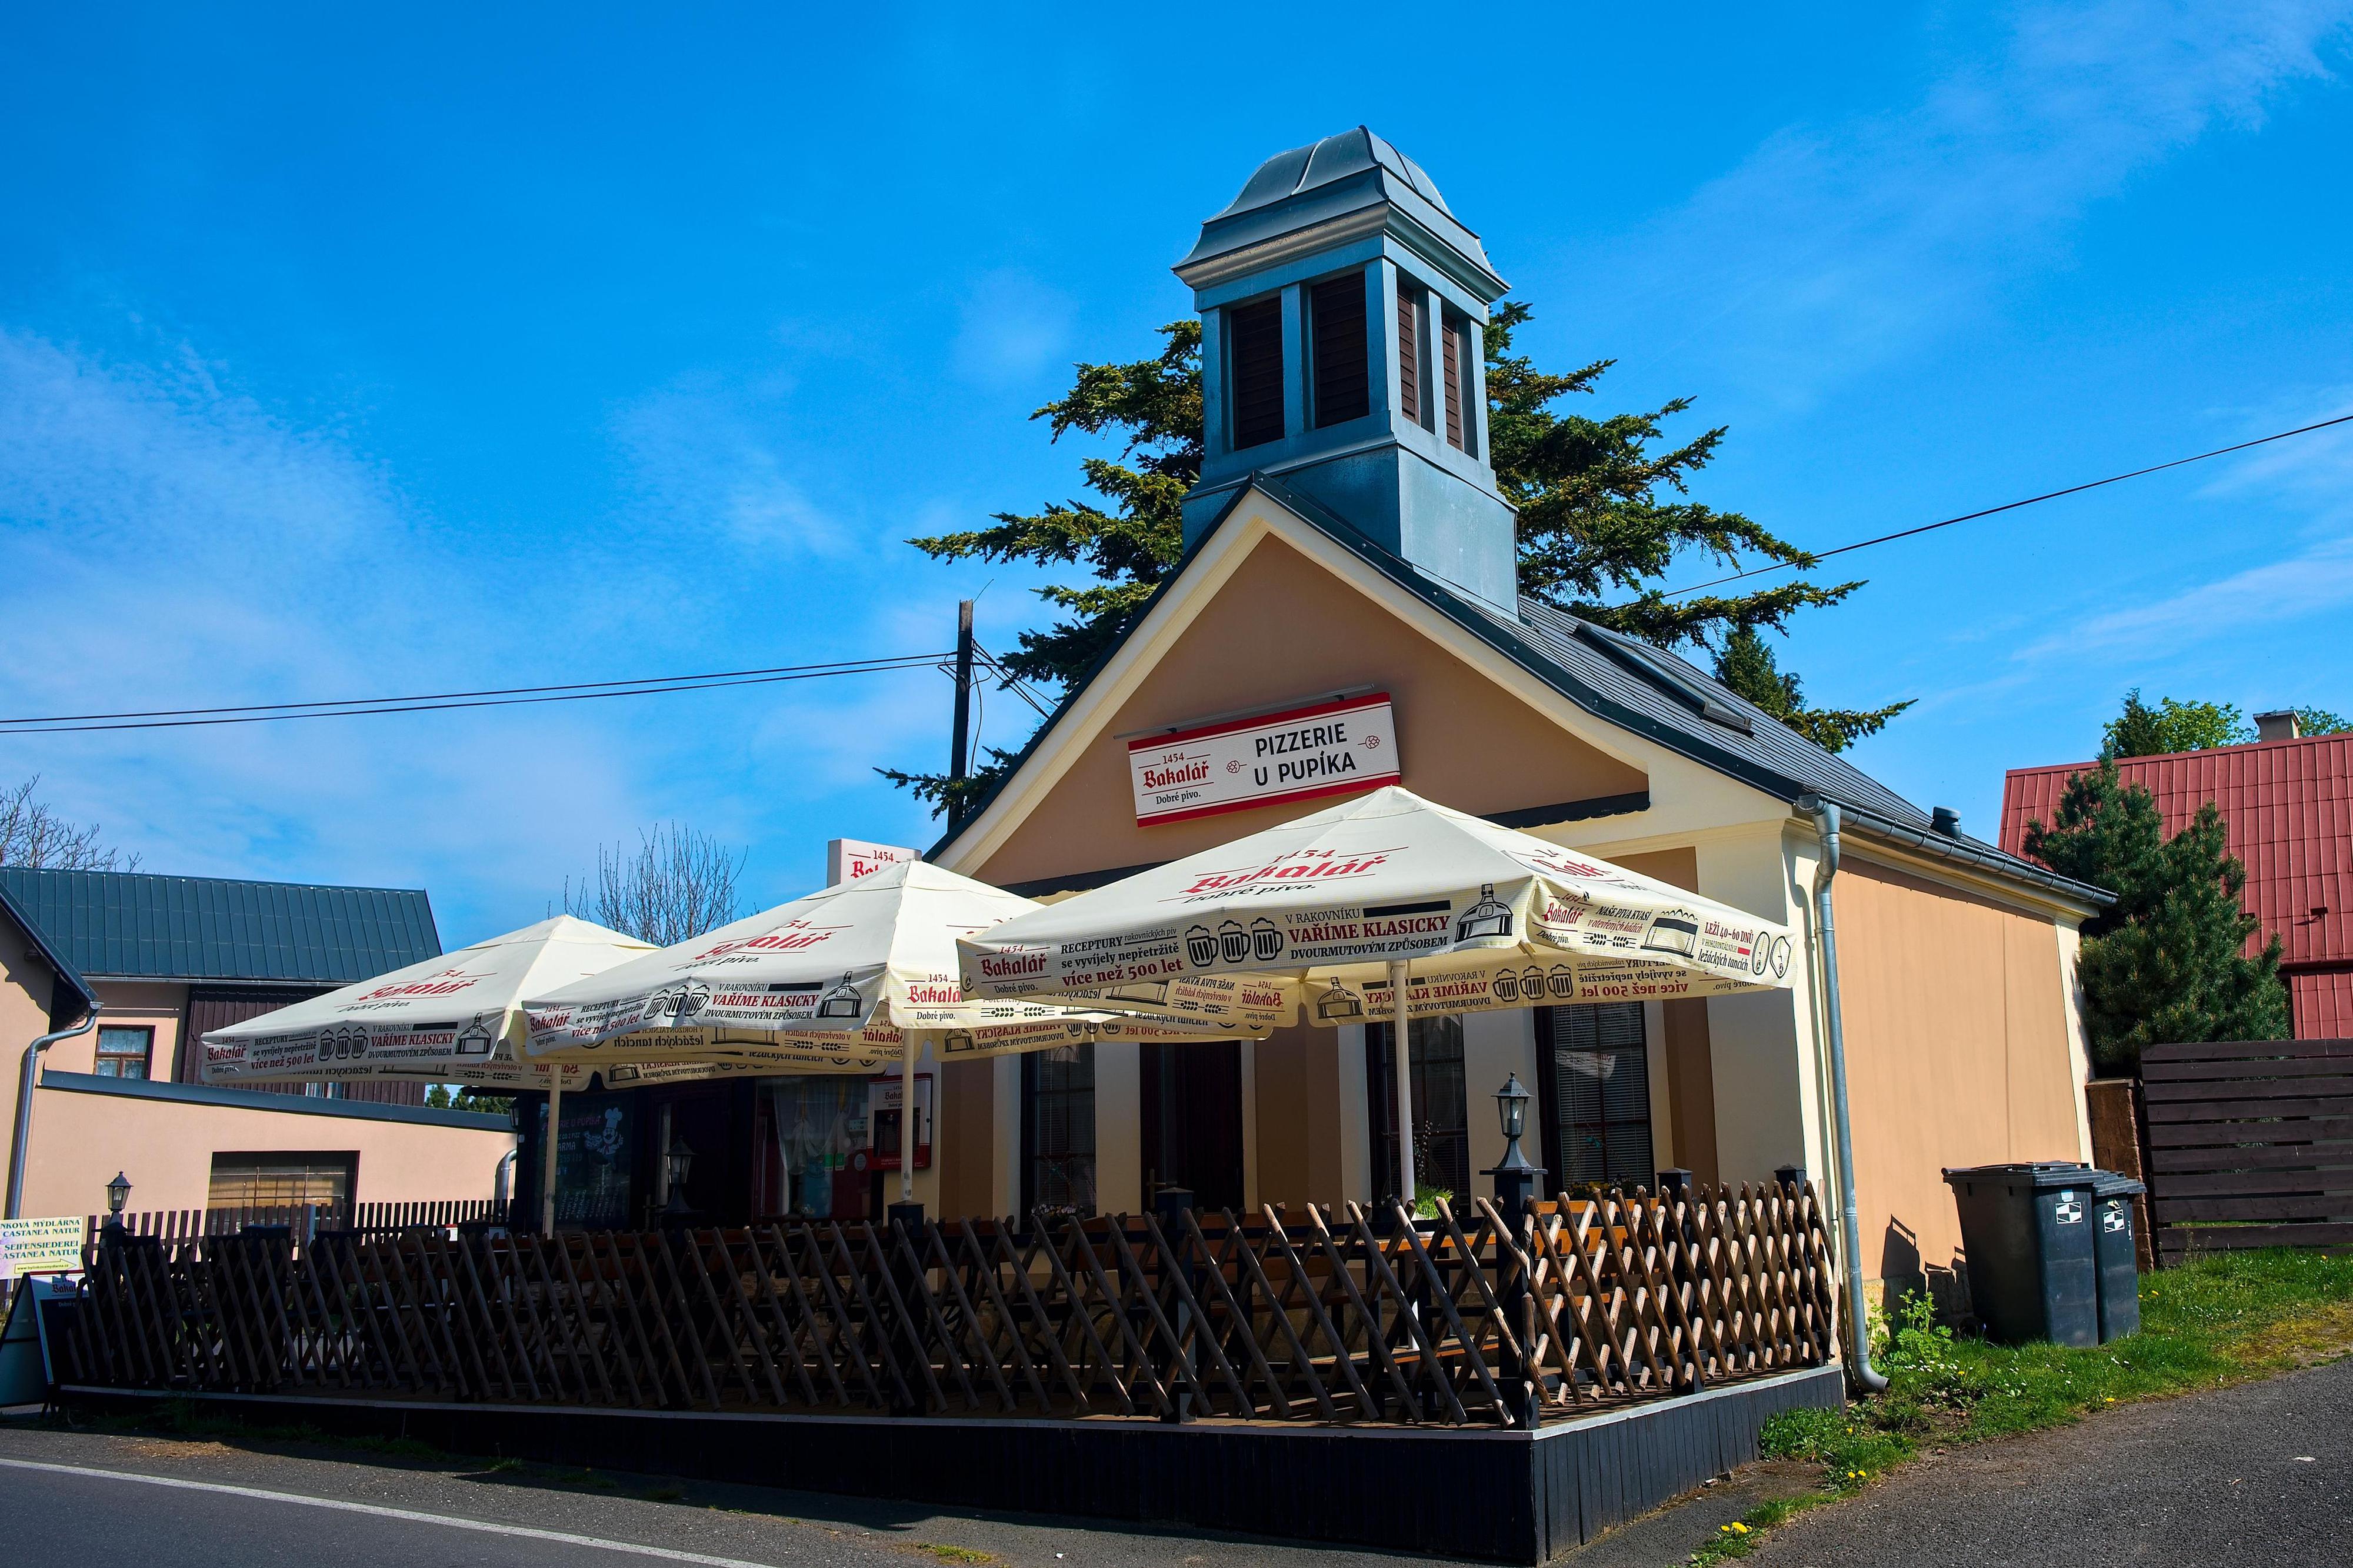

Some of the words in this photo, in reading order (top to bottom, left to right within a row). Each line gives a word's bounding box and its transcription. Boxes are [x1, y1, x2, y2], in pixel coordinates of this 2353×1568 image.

[1256, 723, 1347, 758] PIZZERIE
[1163, 752, 1185, 764] 1454
[1143, 760, 1209, 789] Bakalář
[1255, 768, 1268, 786] U
[1279, 750, 1357, 783] PUPÍKA
[1156, 793, 1179, 805] Dobré
[1181, 791, 1202, 802] pivo.
[874, 850, 894, 862] 1454
[1271, 849, 1336, 865] 1454
[1179, 855, 1389, 893] Bakalář
[1182, 886, 1256, 903] Dobré
[1258, 883, 1317, 895] pivo.
[1562, 894, 1581, 903] 1454
[1285, 914, 1292, 923] V
[1296, 908, 1360, 923] RAKOVNÍKU
[1542, 902, 1587, 925] Bakalář
[1596, 905, 1617, 917] NAŠE
[1617, 909, 1632, 919] PIVA
[1632, 909, 1653, 920] KVASÍ
[1288, 923, 1359, 943] VAŘÍME
[1363, 915, 1451, 938] KLASICKY
[1592, 920, 1624, 933] otevřených
[1623, 923, 1643, 933] kádích
[1705, 922, 1719, 935] LEŽÍ
[1741, 929, 1754, 944] DNŮ
[1061, 936, 1123, 954] RECEPTURY
[1125, 928, 1165, 941] rakovnických
[1166, 928, 1176, 936] piv
[1537, 930, 1557, 942] Dobré
[1558, 934, 1569, 944] pivo.
[999, 945, 1024, 954] 1454
[1291, 942, 1386, 959] DVOURMUTOVÝM
[1388, 936, 1448, 951] ZPŮSOBEM
[1705, 940, 1737, 952] HORIZONTÁLNÍCH
[716, 956, 759, 966] pivo.
[1062, 960, 1072, 968] se
[1075, 953, 1115, 969] vyvíjely
[1119, 942, 1179, 962] nepřetržitě
[1698, 949, 1728, 968] ležáckých
[1728, 956, 1748, 970] tancích
[981, 952, 1047, 977] Bakalář
[928, 974, 948, 982] 1454
[1062, 970, 1092, 986] více
[1096, 965, 1124, 982] než
[1128, 963, 1157, 980] 500
[1162, 958, 1184, 973] let
[724, 982, 768, 992] RAKOVNÍKU
[994, 983, 1016, 993] Dobré
[1018, 983, 1038, 993] pivo.
[712, 993, 761, 1006] VAŘÍME
[760, 995, 819, 1007] KLASICKY
[908, 986, 961, 1003] Bakalá
[545, 1005, 560, 1013] 1454
[581, 999, 621, 1013] RECEPTURY
[586, 1012, 611, 1024] vyvíjely
[611, 1002, 646, 1016] nepřetržitě
[705, 1009, 772, 1020] DVOURMUTOVÝM
[772, 1009, 813, 1020] ZPŮSOBEM
[916, 1011, 938, 1020] Dobré
[939, 1012, 955, 1021] pivo.
[378, 1023, 412, 1032] RAKOVNÍKU
[530, 1012, 570, 1033] Bakalář
[572, 1026, 592, 1037] více
[610, 1019, 626, 1029] 500
[628, 1013, 640, 1026] let
[255, 1035, 288, 1046] RECEPTURY
[372, 1033, 407, 1046] VAŘÍME
[408, 1033, 455, 1045] KLASICKY
[208, 1045, 246, 1060] Bakalář
[261, 1045, 284, 1056] vyvíjely
[284, 1042, 316, 1053] nepřetržitě
[368, 1048, 419, 1058] DVOURMUTOVÝM
[419, 1047, 452, 1056] ZPŮSOBEM
[251, 1059, 268, 1069] více
[269, 1054, 284, 1067] než
[286, 1057, 302, 1067] 500
[303, 1054, 314, 1064] let
[212, 1065, 224, 1074] Dobré
[4, 1229, 49, 1237] CASTANEA
[5, 1240, 78, 1251] SEIFENSIEDEREI
